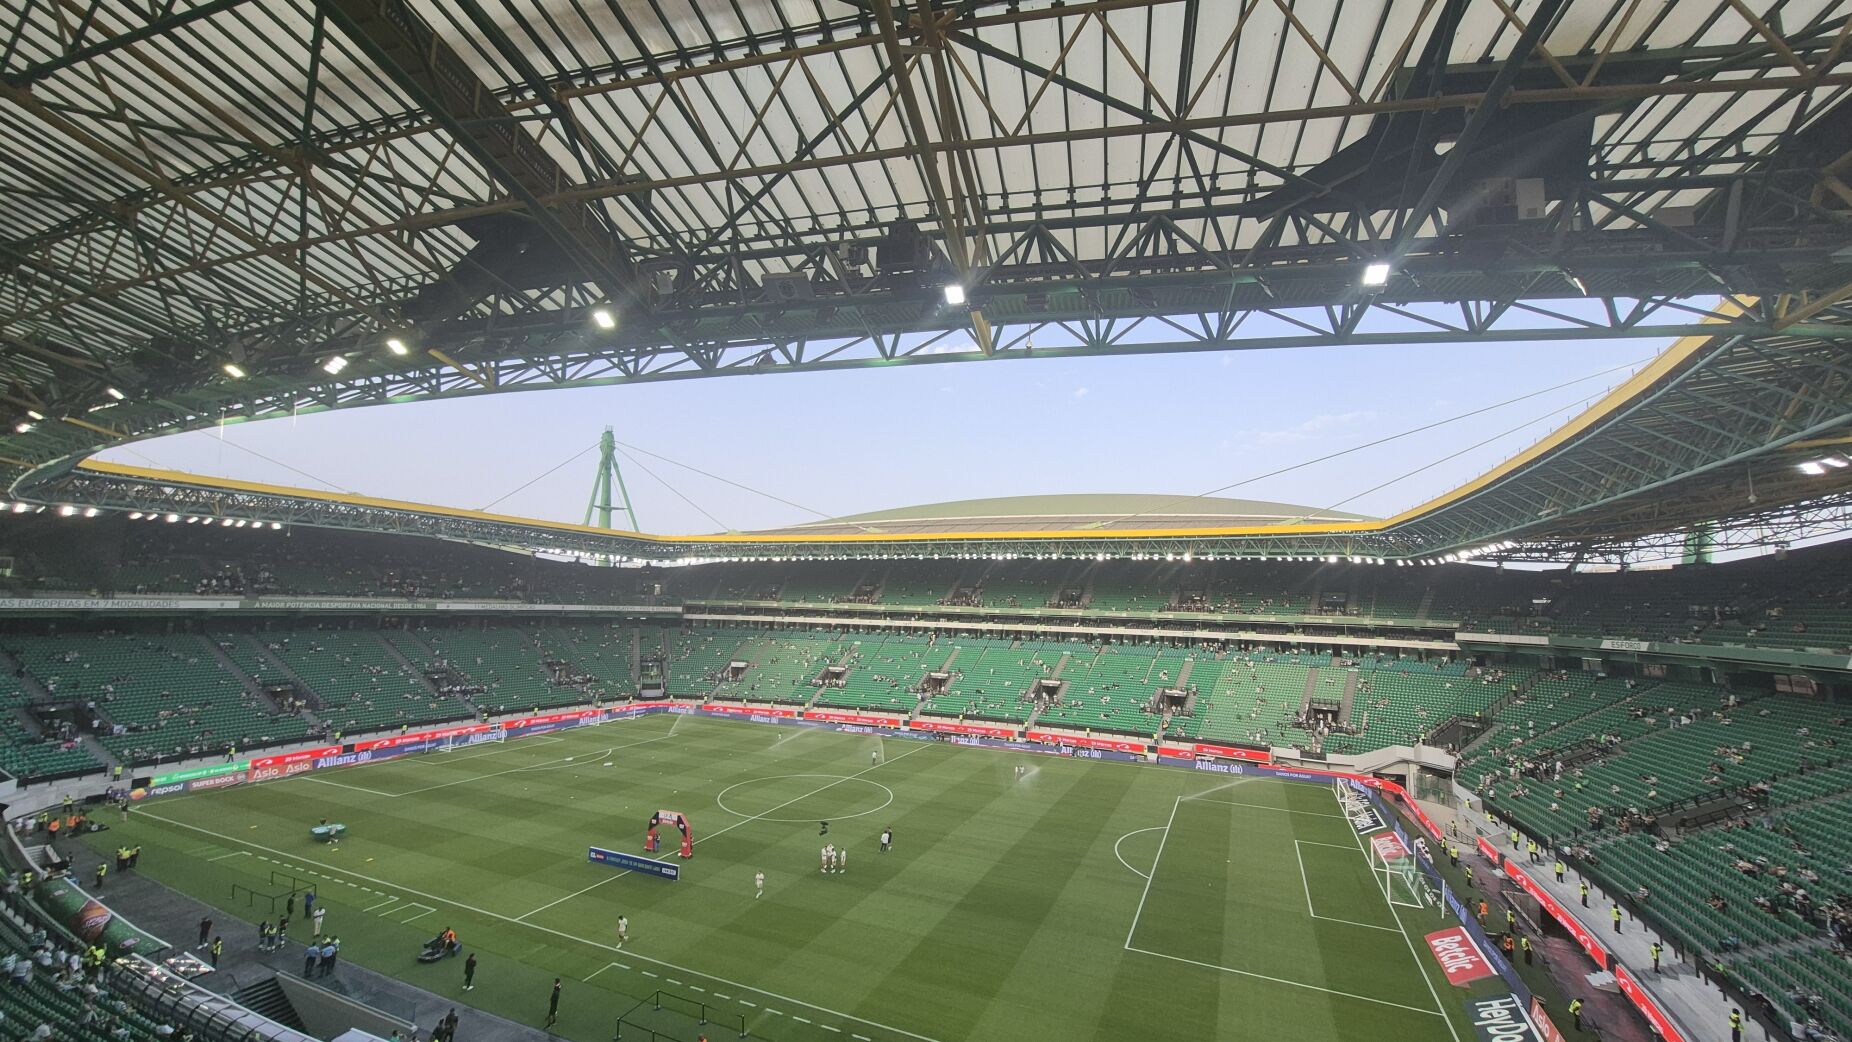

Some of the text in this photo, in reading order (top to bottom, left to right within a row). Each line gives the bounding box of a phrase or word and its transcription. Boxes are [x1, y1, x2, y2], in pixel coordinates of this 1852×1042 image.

[19, 600, 81, 608] EUROPEIAS
[84, 600, 99, 608] EM
[317, 754, 356, 768] Allianz
[1195, 760, 1229, 772] Allianz
[151, 783, 184, 795] repsol
[192, 779, 214, 788] SUPER
[1431, 935, 1480, 973] Betclic
